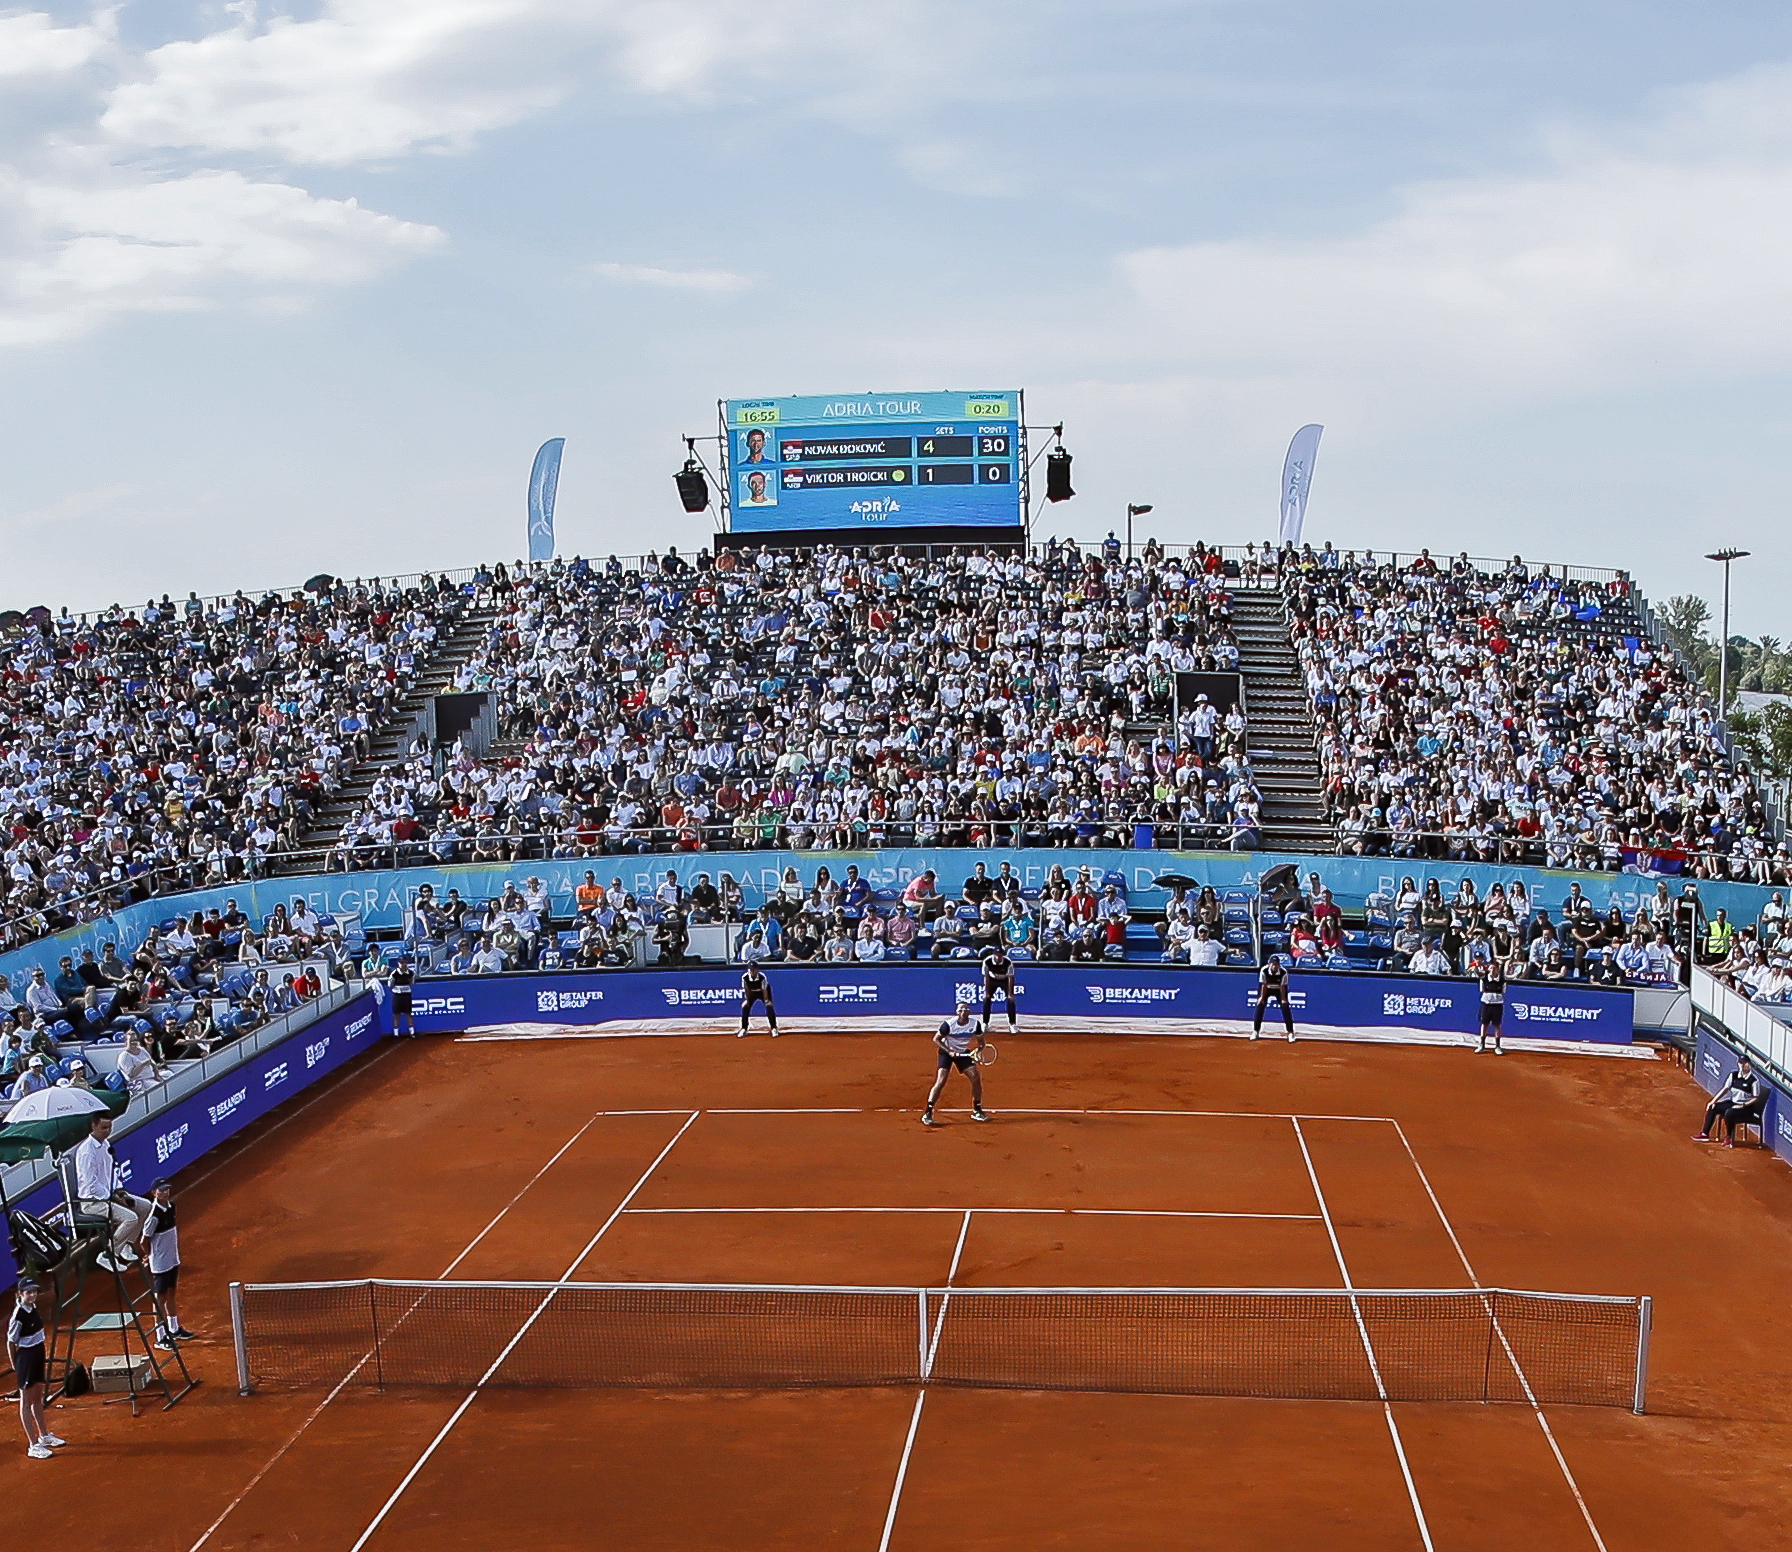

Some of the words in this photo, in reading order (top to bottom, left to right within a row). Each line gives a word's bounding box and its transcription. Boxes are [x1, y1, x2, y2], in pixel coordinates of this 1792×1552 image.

[822, 402, 874, 418] ADRIA
[876, 400, 923, 415] TOUR
[972, 404, 1001, 414] 0:20
[744, 411, 775, 422] 16:55
[934, 426, 955, 435] SETS
[978, 425, 1008, 434] POINTS
[804, 444, 839, 456] NOVAK
[923, 440, 935, 453] 4
[982, 438, 1005, 453] 30
[805, 472, 844, 484] VIKTOR
[847, 471, 888, 482] TROICKI
[925, 468, 934, 481] 1
[988, 467, 999, 480] 0
[849, 496, 901, 514] ADRIA
[862, 513, 888, 521] tour
[559, 991, 604, 1001] METALFER
[681, 988, 746, 1001] BEKAMENT
[1105, 987, 1180, 1001] BEKAMENT
[559, 1000, 588, 1009] GROUP
[1406, 997, 1452, 1008] METALFER
[1406, 1005, 1436, 1015] GROUP
[1530, 1006, 1603, 1020] BEKAMENT
